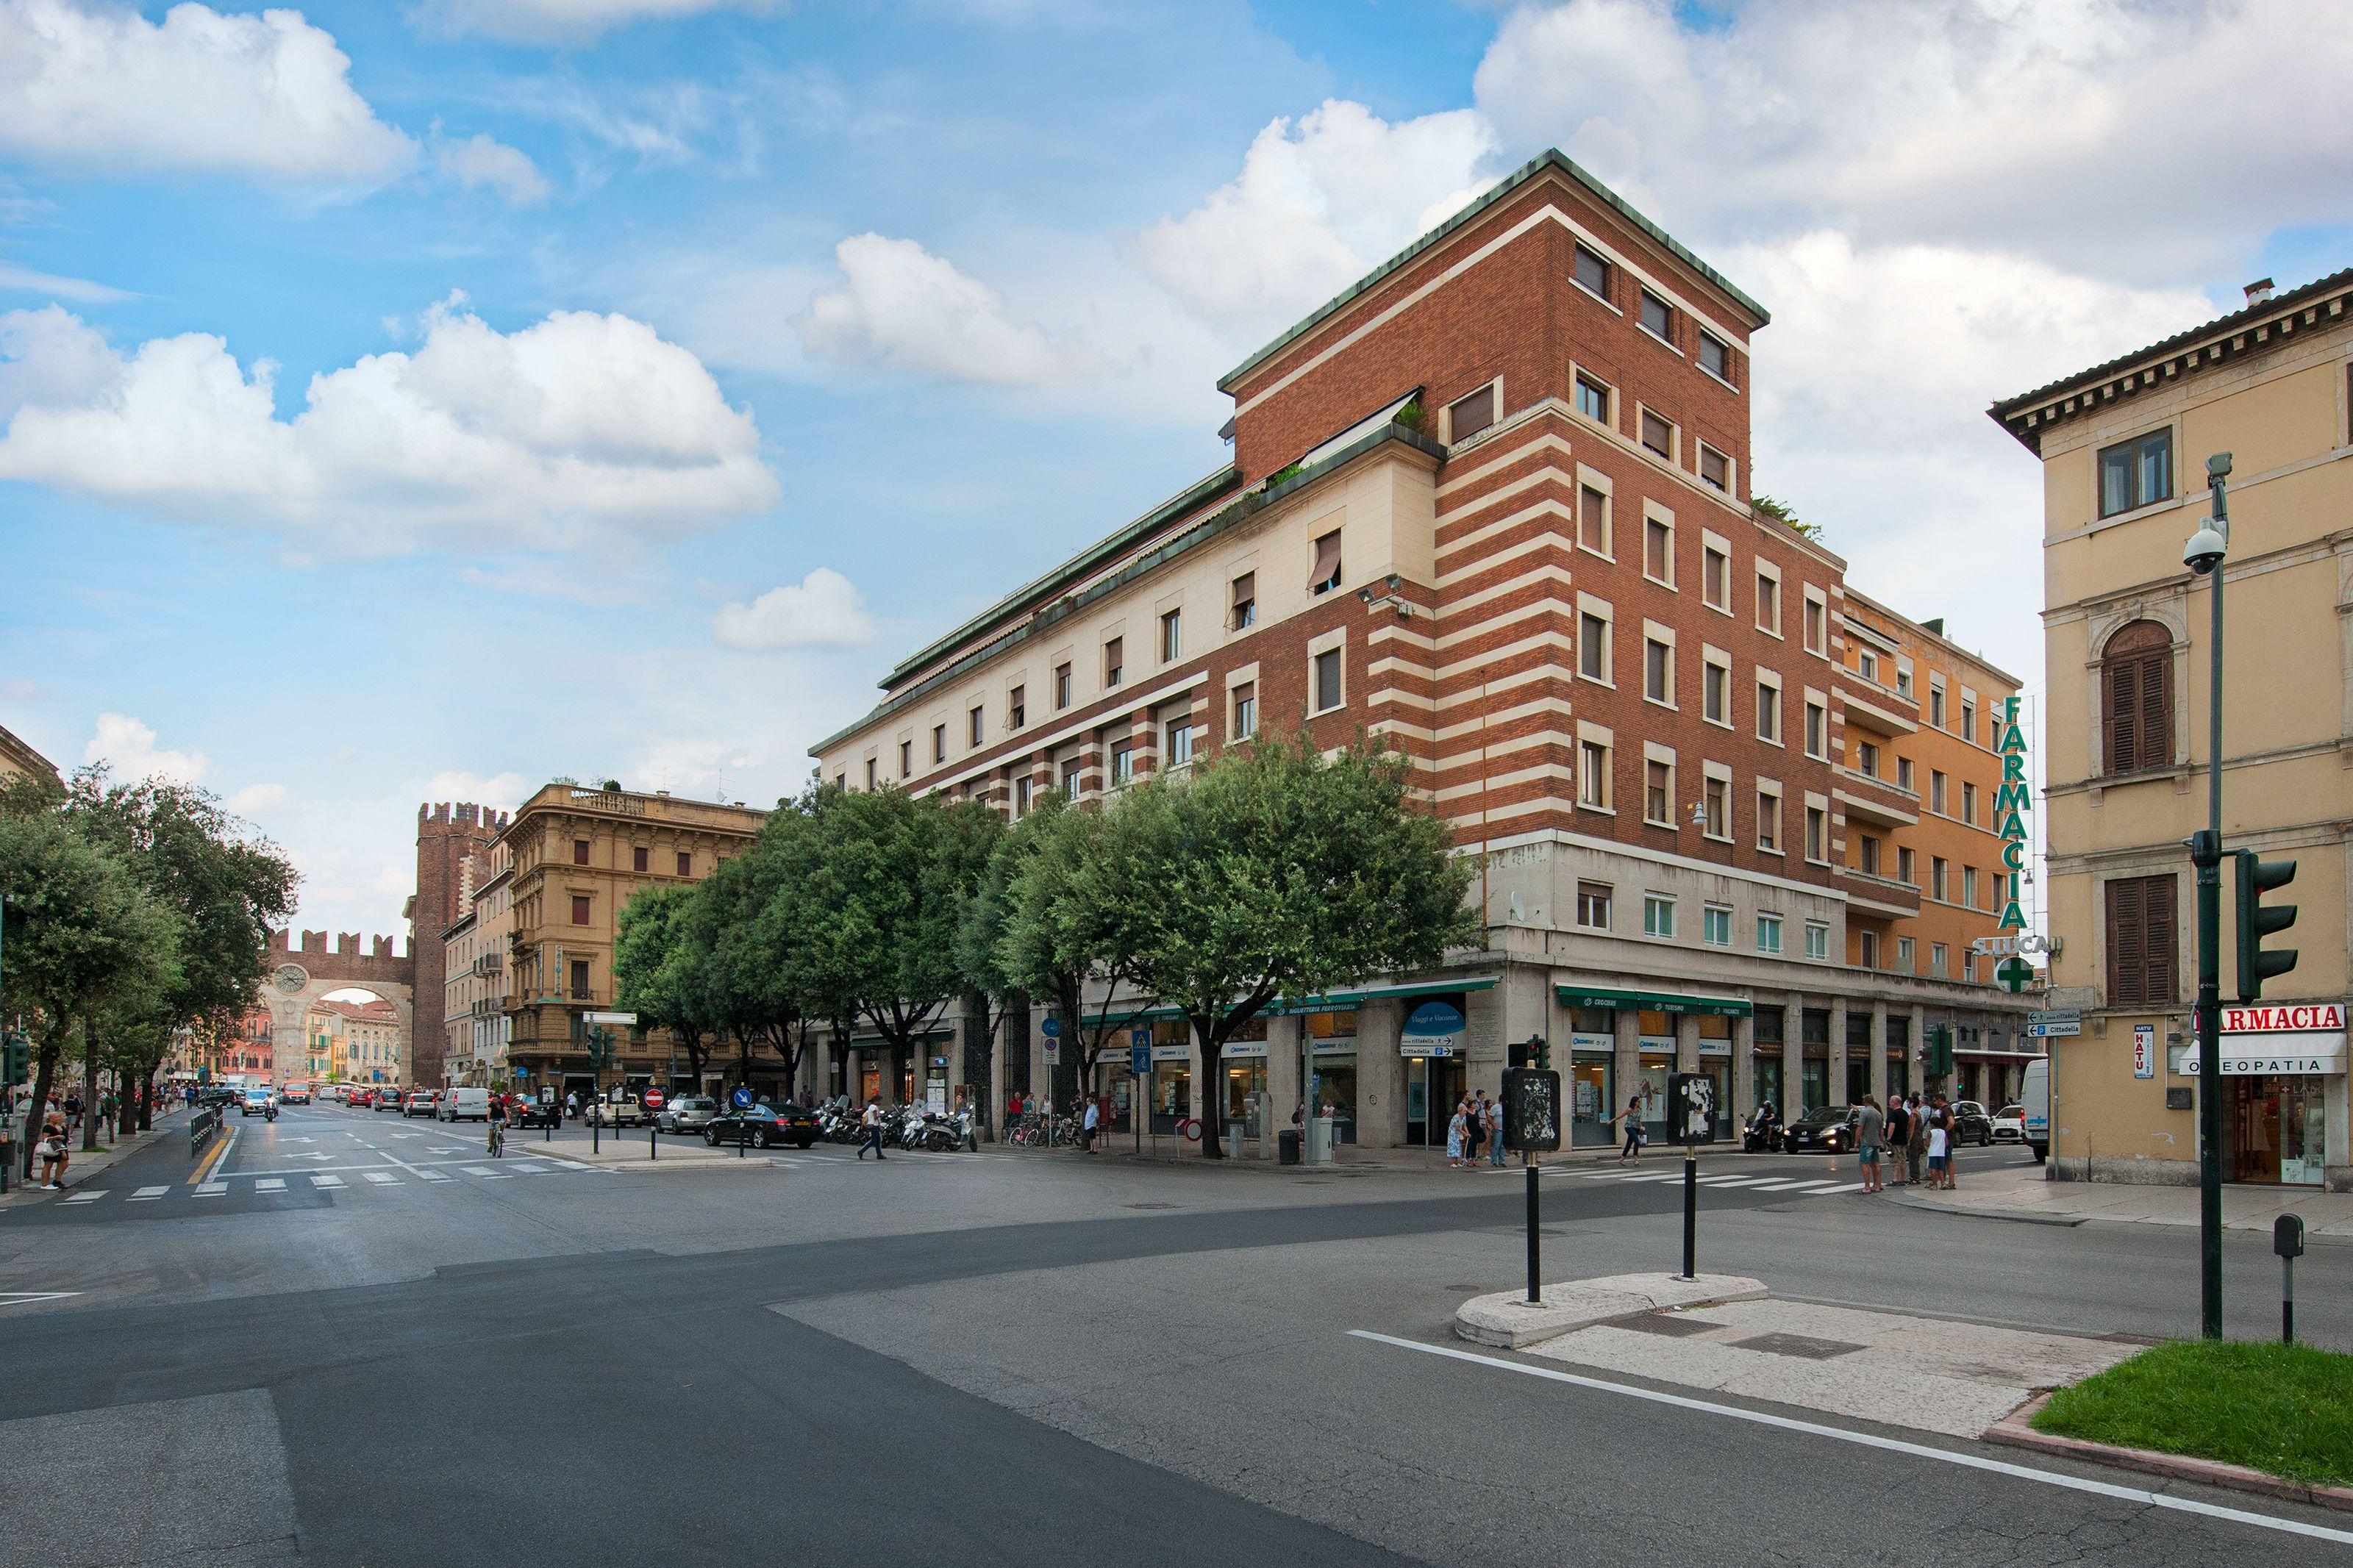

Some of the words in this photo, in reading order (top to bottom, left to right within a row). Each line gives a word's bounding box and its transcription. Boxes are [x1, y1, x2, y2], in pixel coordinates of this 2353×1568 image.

[1996, 697, 2030, 929] FARMACIA
[1321, 1003, 1356, 1012] FERROVIARIA
[1412, 1016, 1428, 1024] Viaggi
[2196, 1006, 2341, 1031] RMACIA
[2135, 1034, 2143, 1070] HATU
[2189, 1060, 2320, 1072] OEOPATIA
